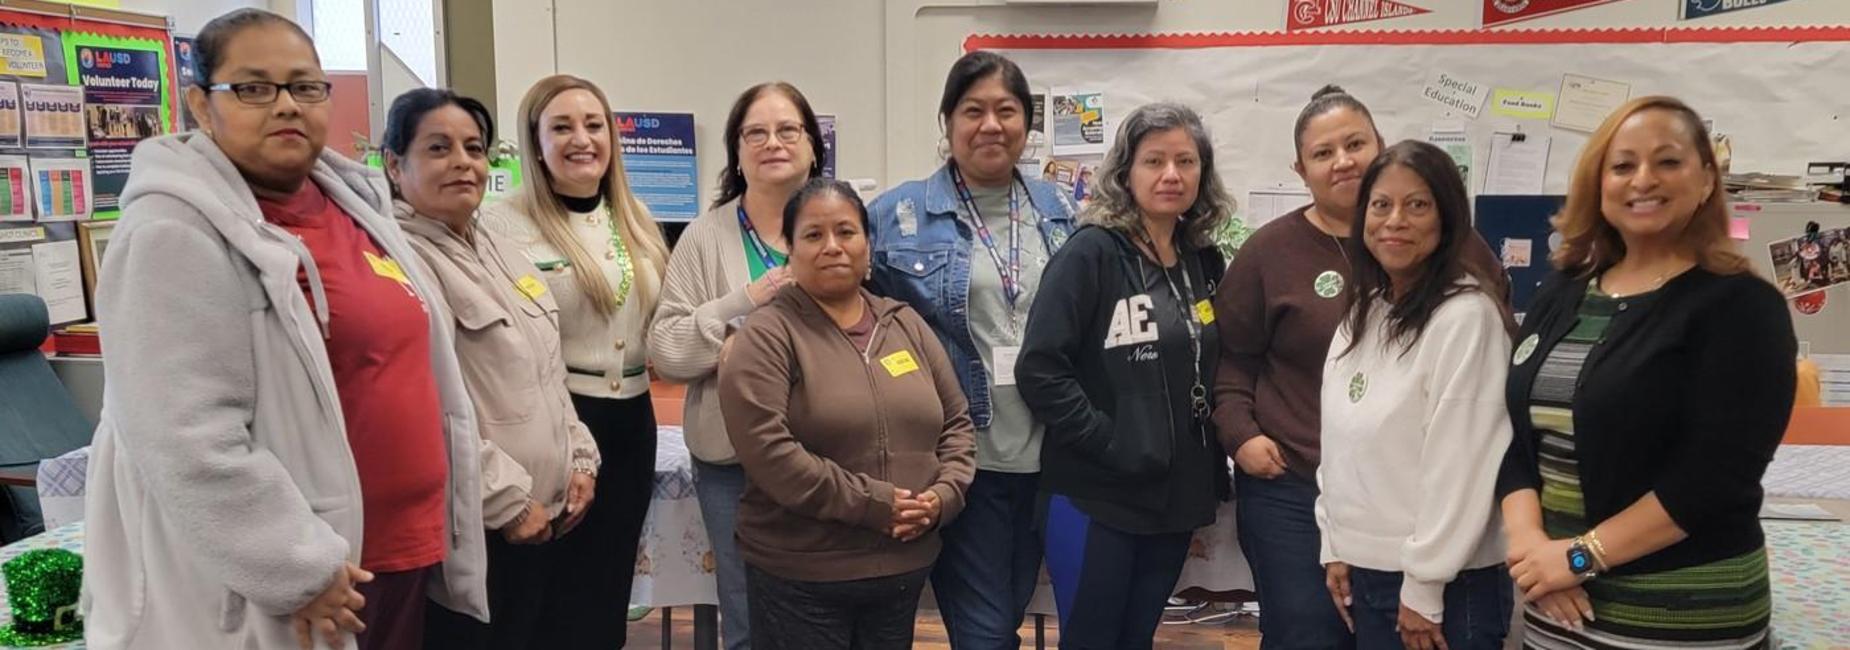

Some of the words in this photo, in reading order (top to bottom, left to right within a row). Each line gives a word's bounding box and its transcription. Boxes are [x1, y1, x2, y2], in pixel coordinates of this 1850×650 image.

[95, 51, 131, 64] LAUSD
[82, 75, 131, 88] Volunteer
[131, 77, 159, 92] Today
[1438, 73, 1477, 96] Special
[1424, 86, 1477, 115] Education
[615, 116, 660, 129] LAUSD
[649, 146, 693, 154] Estudiantes
[1104, 293, 1159, 350] AE
